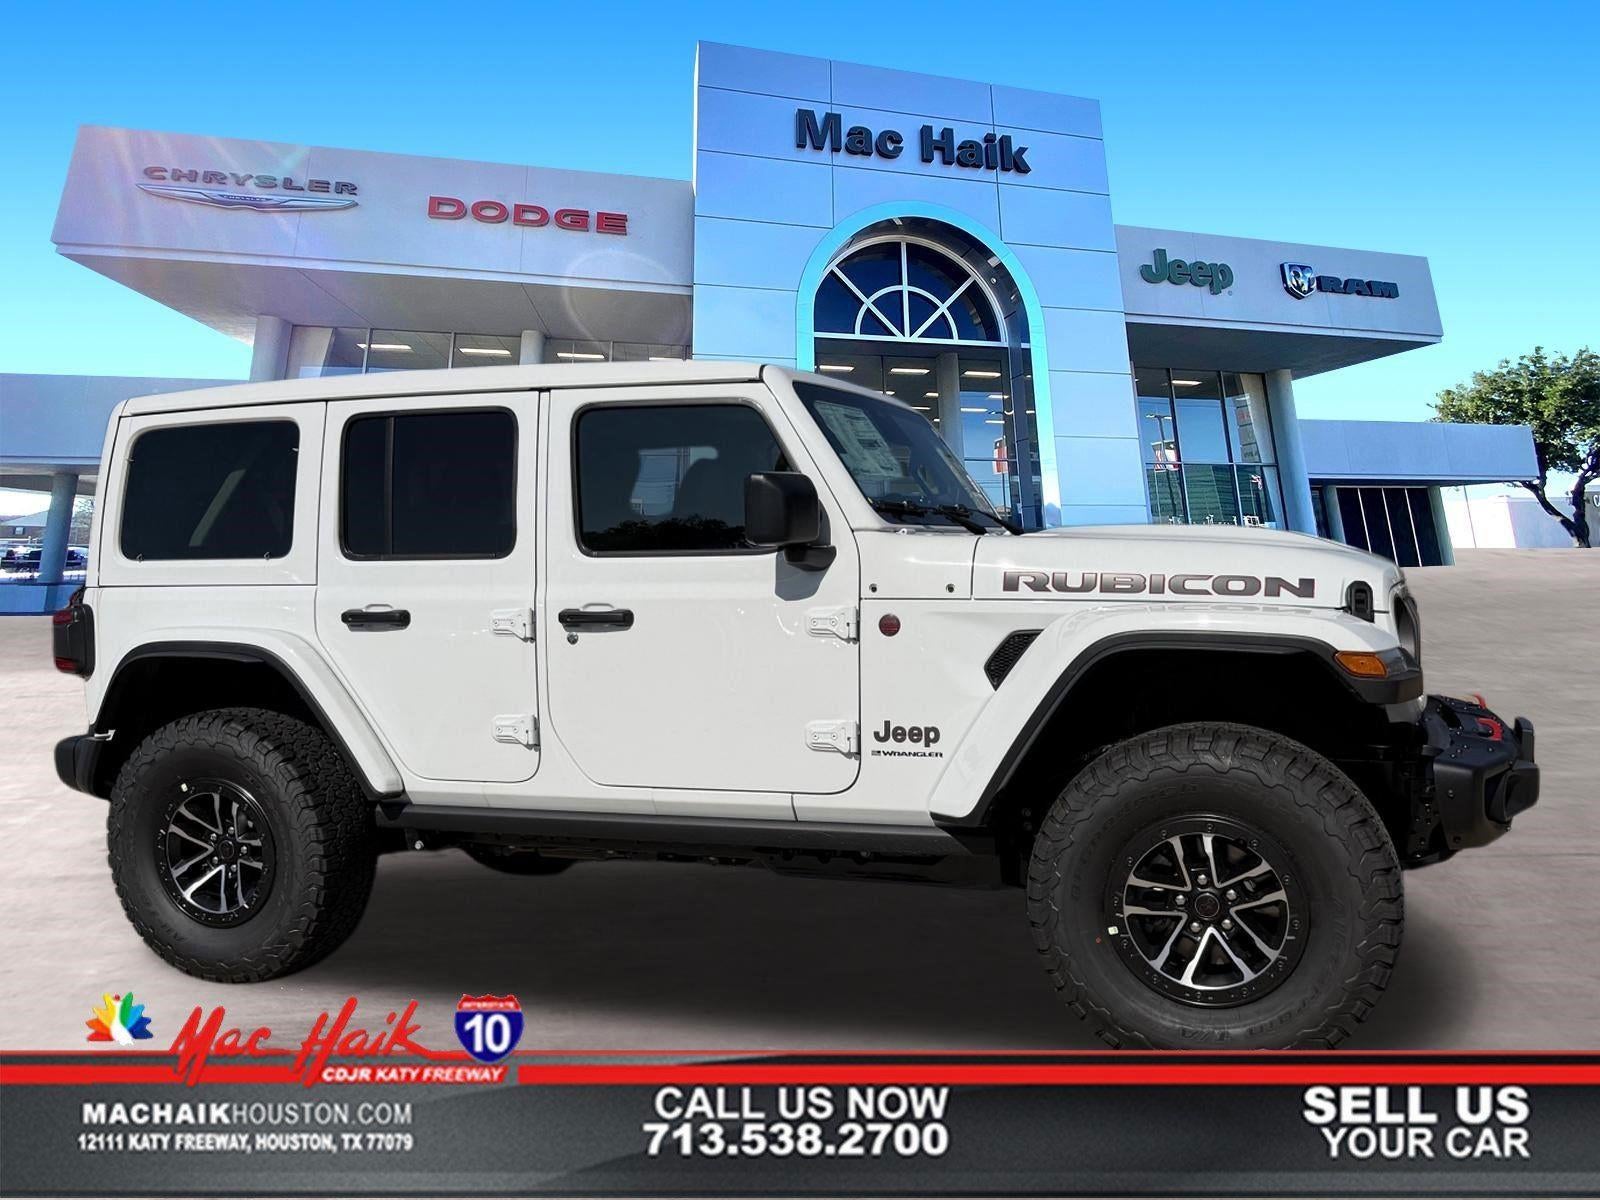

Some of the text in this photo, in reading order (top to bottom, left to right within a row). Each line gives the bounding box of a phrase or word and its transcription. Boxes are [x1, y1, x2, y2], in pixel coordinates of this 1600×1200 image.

[795, 108, 1031, 175] Mac Haik
[143, 166, 359, 196] CHRYSLER
[428, 195, 628, 236] DODGE
[1140, 248, 1234, 295] Jeep
[1316, 275, 1399, 299] RAM
[1002, 571, 1315, 598] RUBICON
[873, 720, 941, 747] Jeep
[882, 750, 943, 758] WRANGLER
